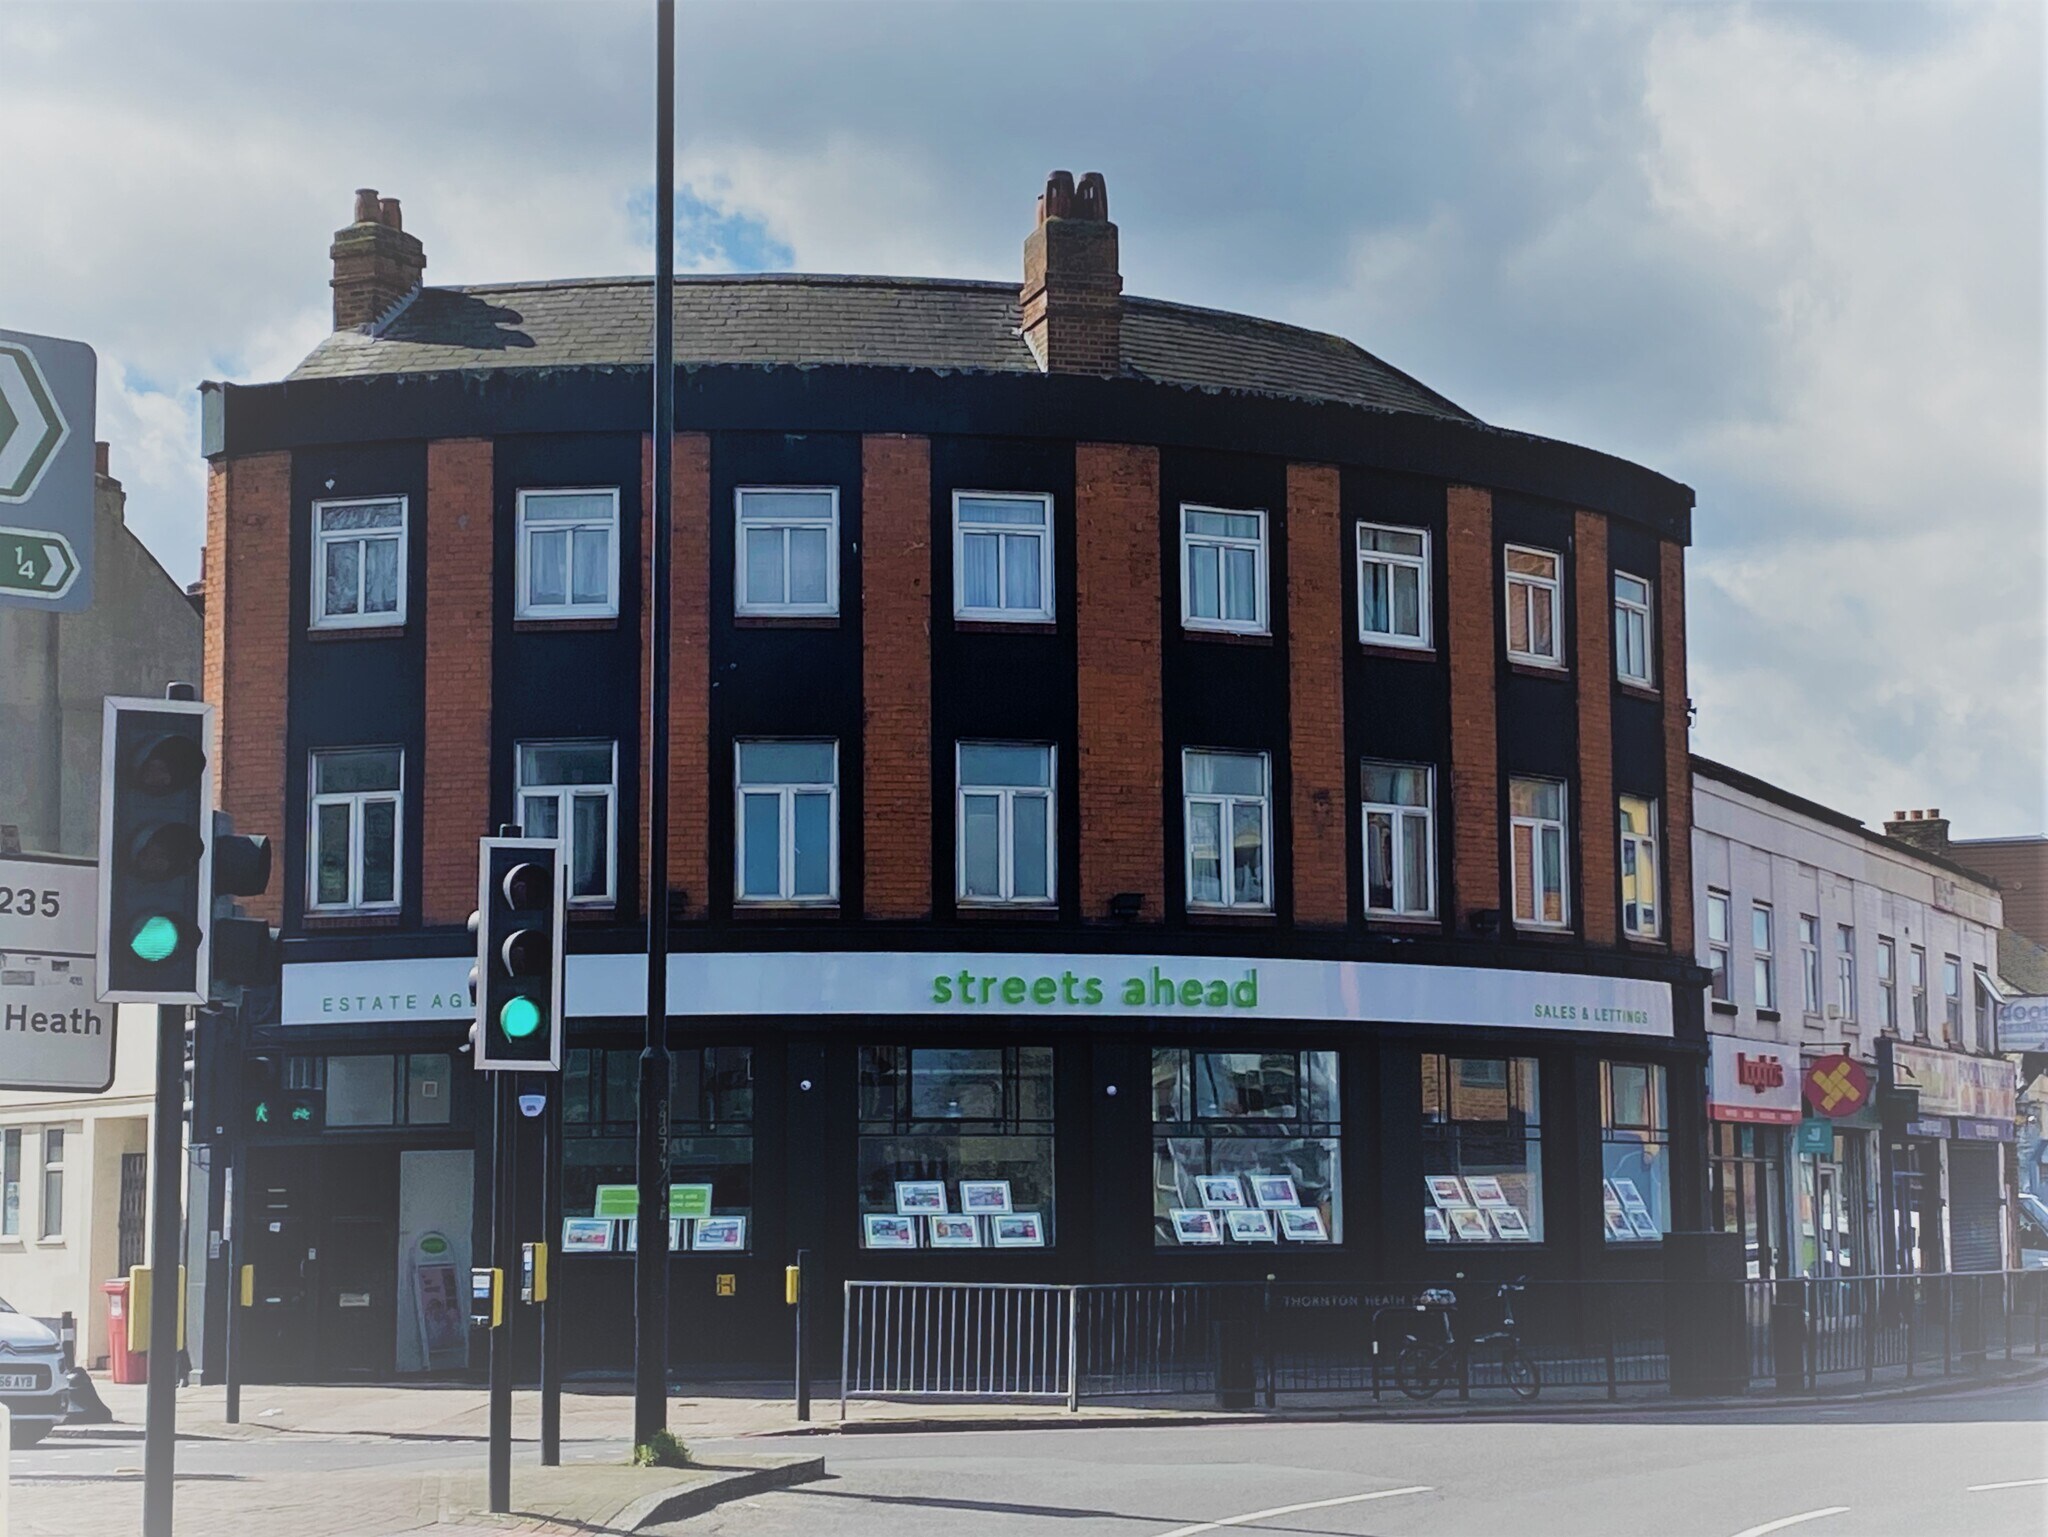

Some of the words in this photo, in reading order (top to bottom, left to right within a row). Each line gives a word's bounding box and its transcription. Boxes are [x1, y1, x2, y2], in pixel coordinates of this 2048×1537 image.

[932, 969, 1103, 1005] streets
[1122, 966, 1258, 1008] ahead
[322, 994, 417, 1012] ESTATE
[1534, 1003, 1576, 1020] SALES
[1582, 1007, 1589, 1020] &
[1594, 1008, 1648, 1024] LETTINGS
[5, 1003, 101, 1035] Heath
[1283, 1295, 1358, 1307] THORNTON
[1365, 1295, 1406, 1306] HEATH
